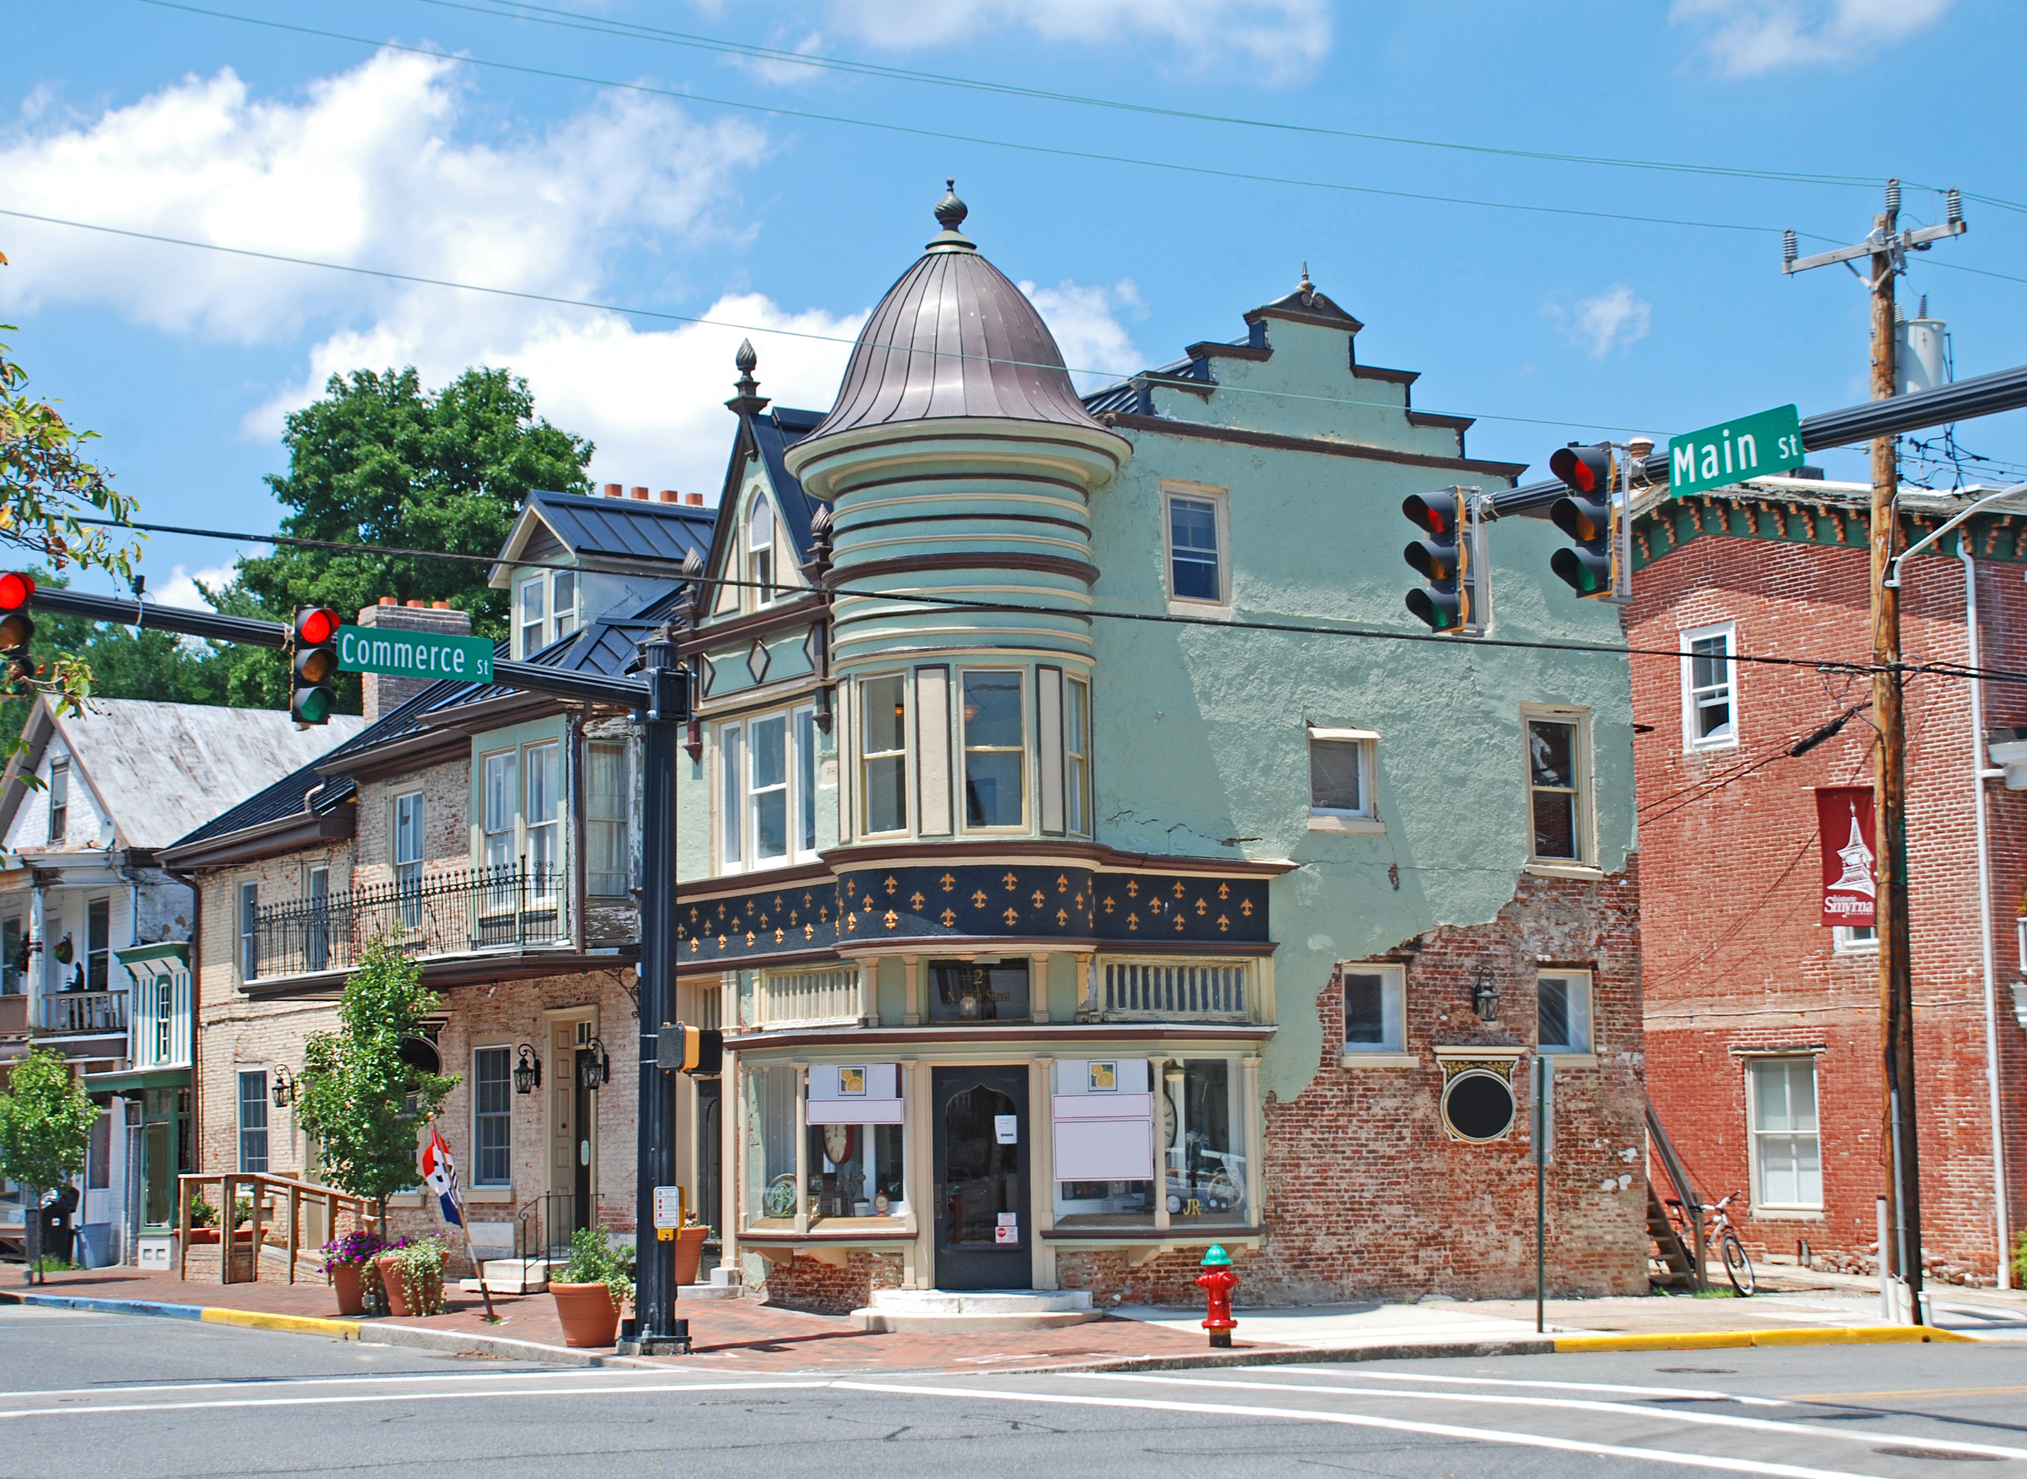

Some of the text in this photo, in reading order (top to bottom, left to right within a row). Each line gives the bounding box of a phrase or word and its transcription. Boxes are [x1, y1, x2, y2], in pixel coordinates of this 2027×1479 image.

[1673, 429, 1799, 487] Main St
[342, 633, 489, 675] Commerce St
[1824, 896, 1874, 918] Smyrna
[973, 969, 983, 985] 2
[1183, 1199, 1201, 1216] JR
